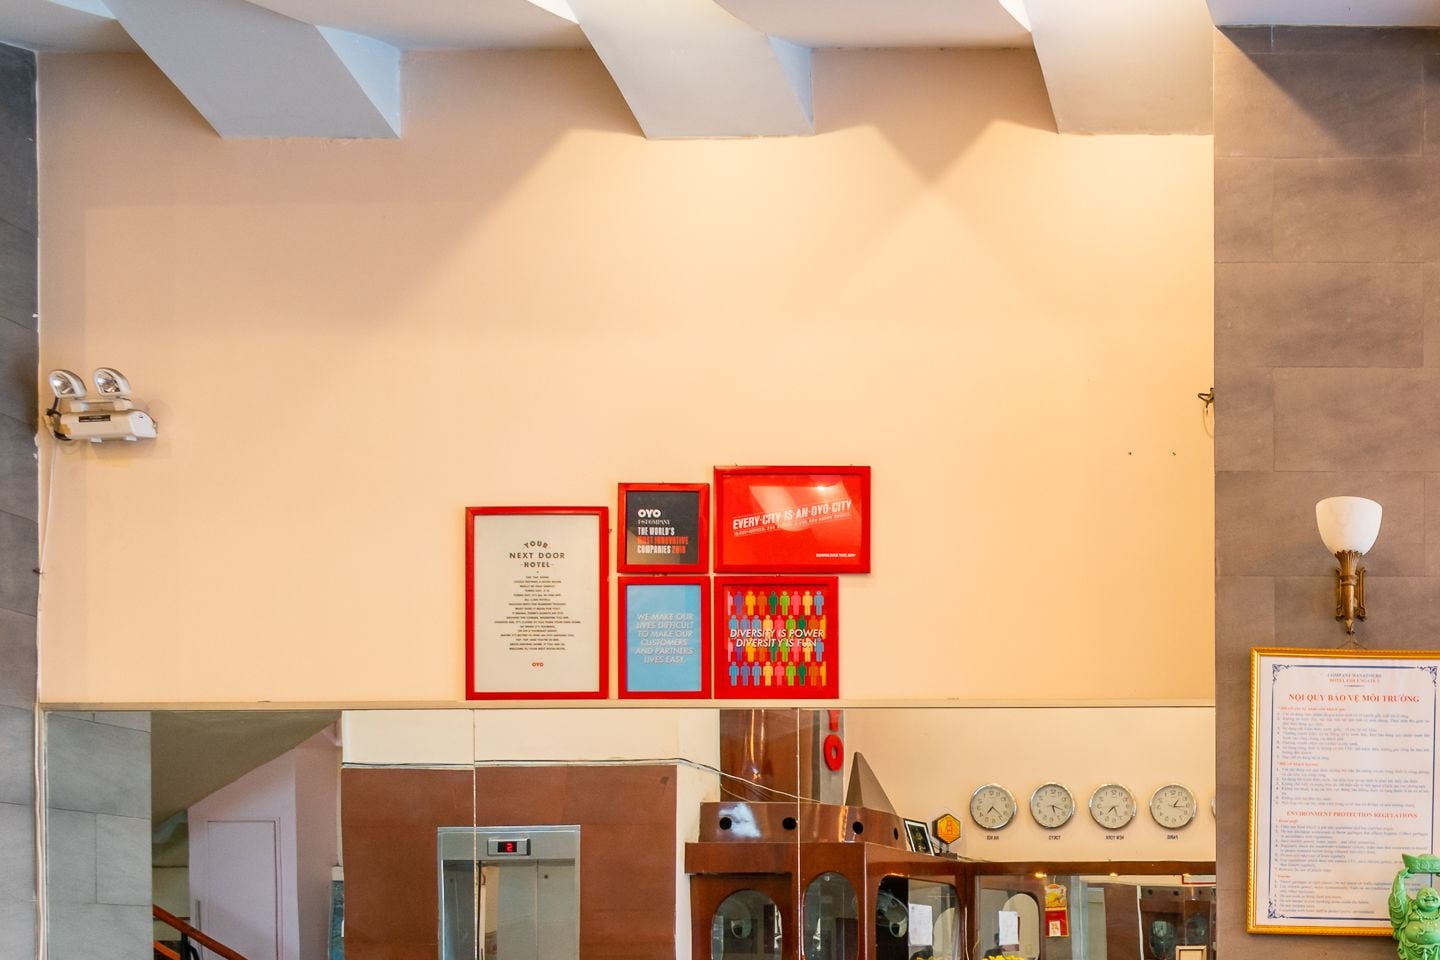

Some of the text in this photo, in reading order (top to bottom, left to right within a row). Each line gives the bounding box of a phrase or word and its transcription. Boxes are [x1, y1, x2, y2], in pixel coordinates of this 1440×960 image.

[638, 509, 661, 518] OYO
[732, 516, 760, 530] EVERY
[762, 512, 780, 525] CITY
[784, 509, 793, 520] IS
[796, 506, 808, 519] AN
[812, 503, 829, 516] OYO
[832, 500, 852, 512] CITY
[638, 527, 675, 536] THE WORLD'S
[524, 540, 548, 548] YOUR
[638, 545, 671, 554] COMPANIES
[730, 629, 824, 637] DIVERSITY IS POWER
[736, 639, 816, 647] DIVERSITY IS FUN
